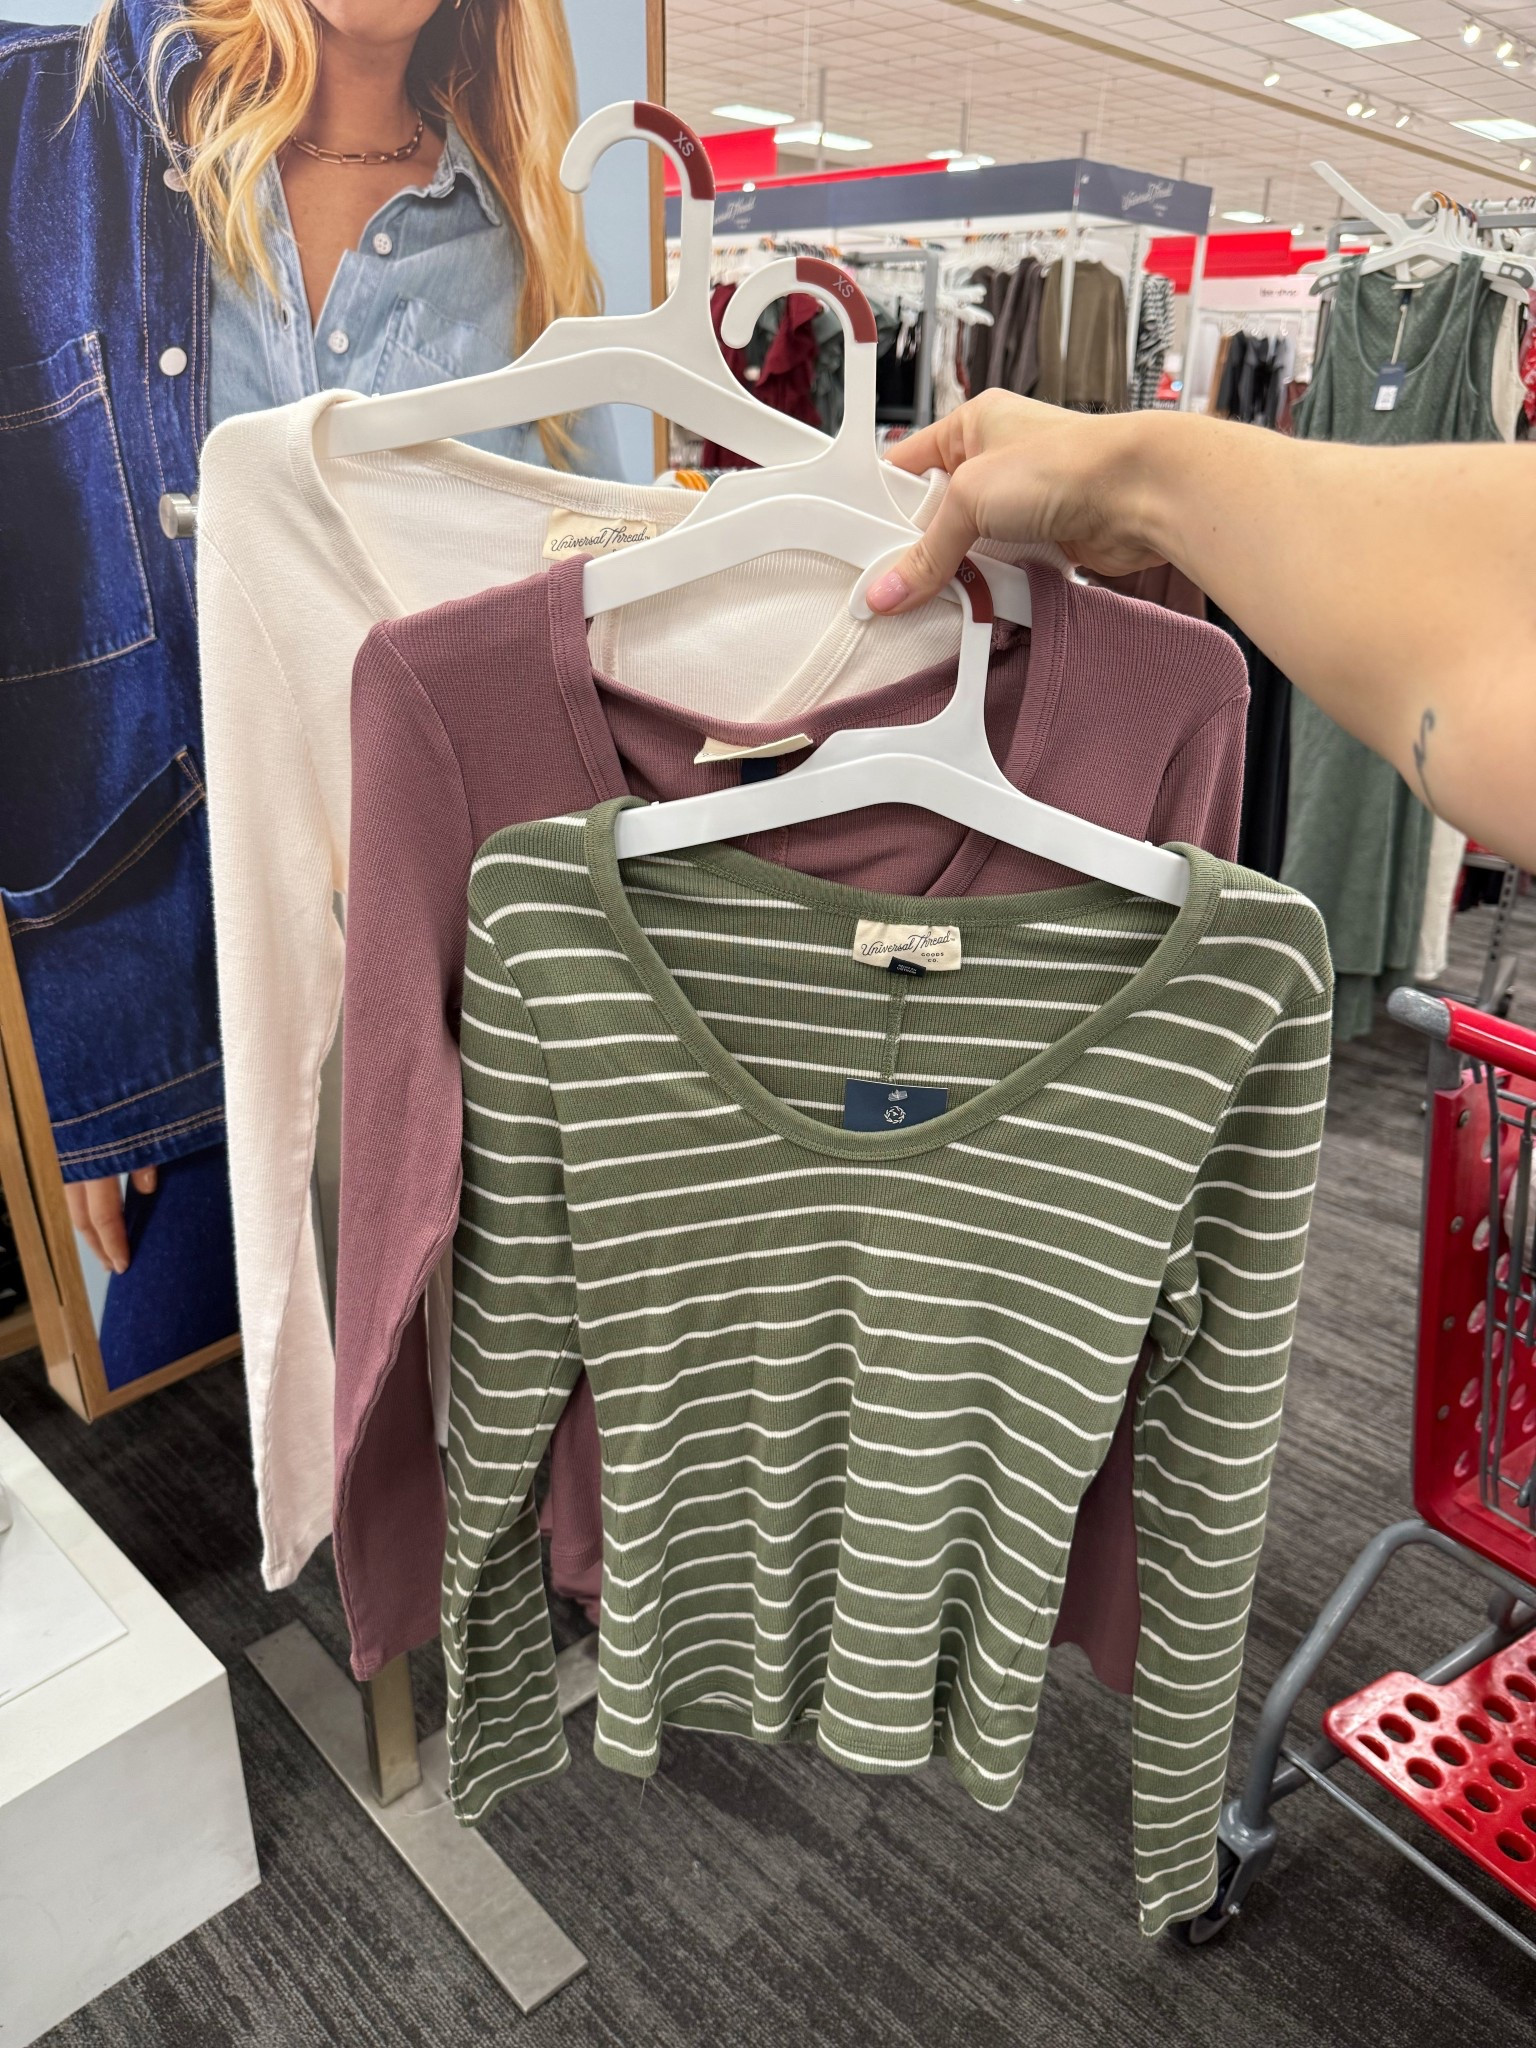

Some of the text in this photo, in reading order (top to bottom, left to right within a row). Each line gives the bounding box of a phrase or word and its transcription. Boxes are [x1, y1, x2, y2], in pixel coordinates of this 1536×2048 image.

[673, 130, 695, 157] XS
[832, 274, 854, 298] XS
[551, 530, 608, 552] Universal
[958, 561, 976, 584] XS
[861, 937, 916, 956] Universal
